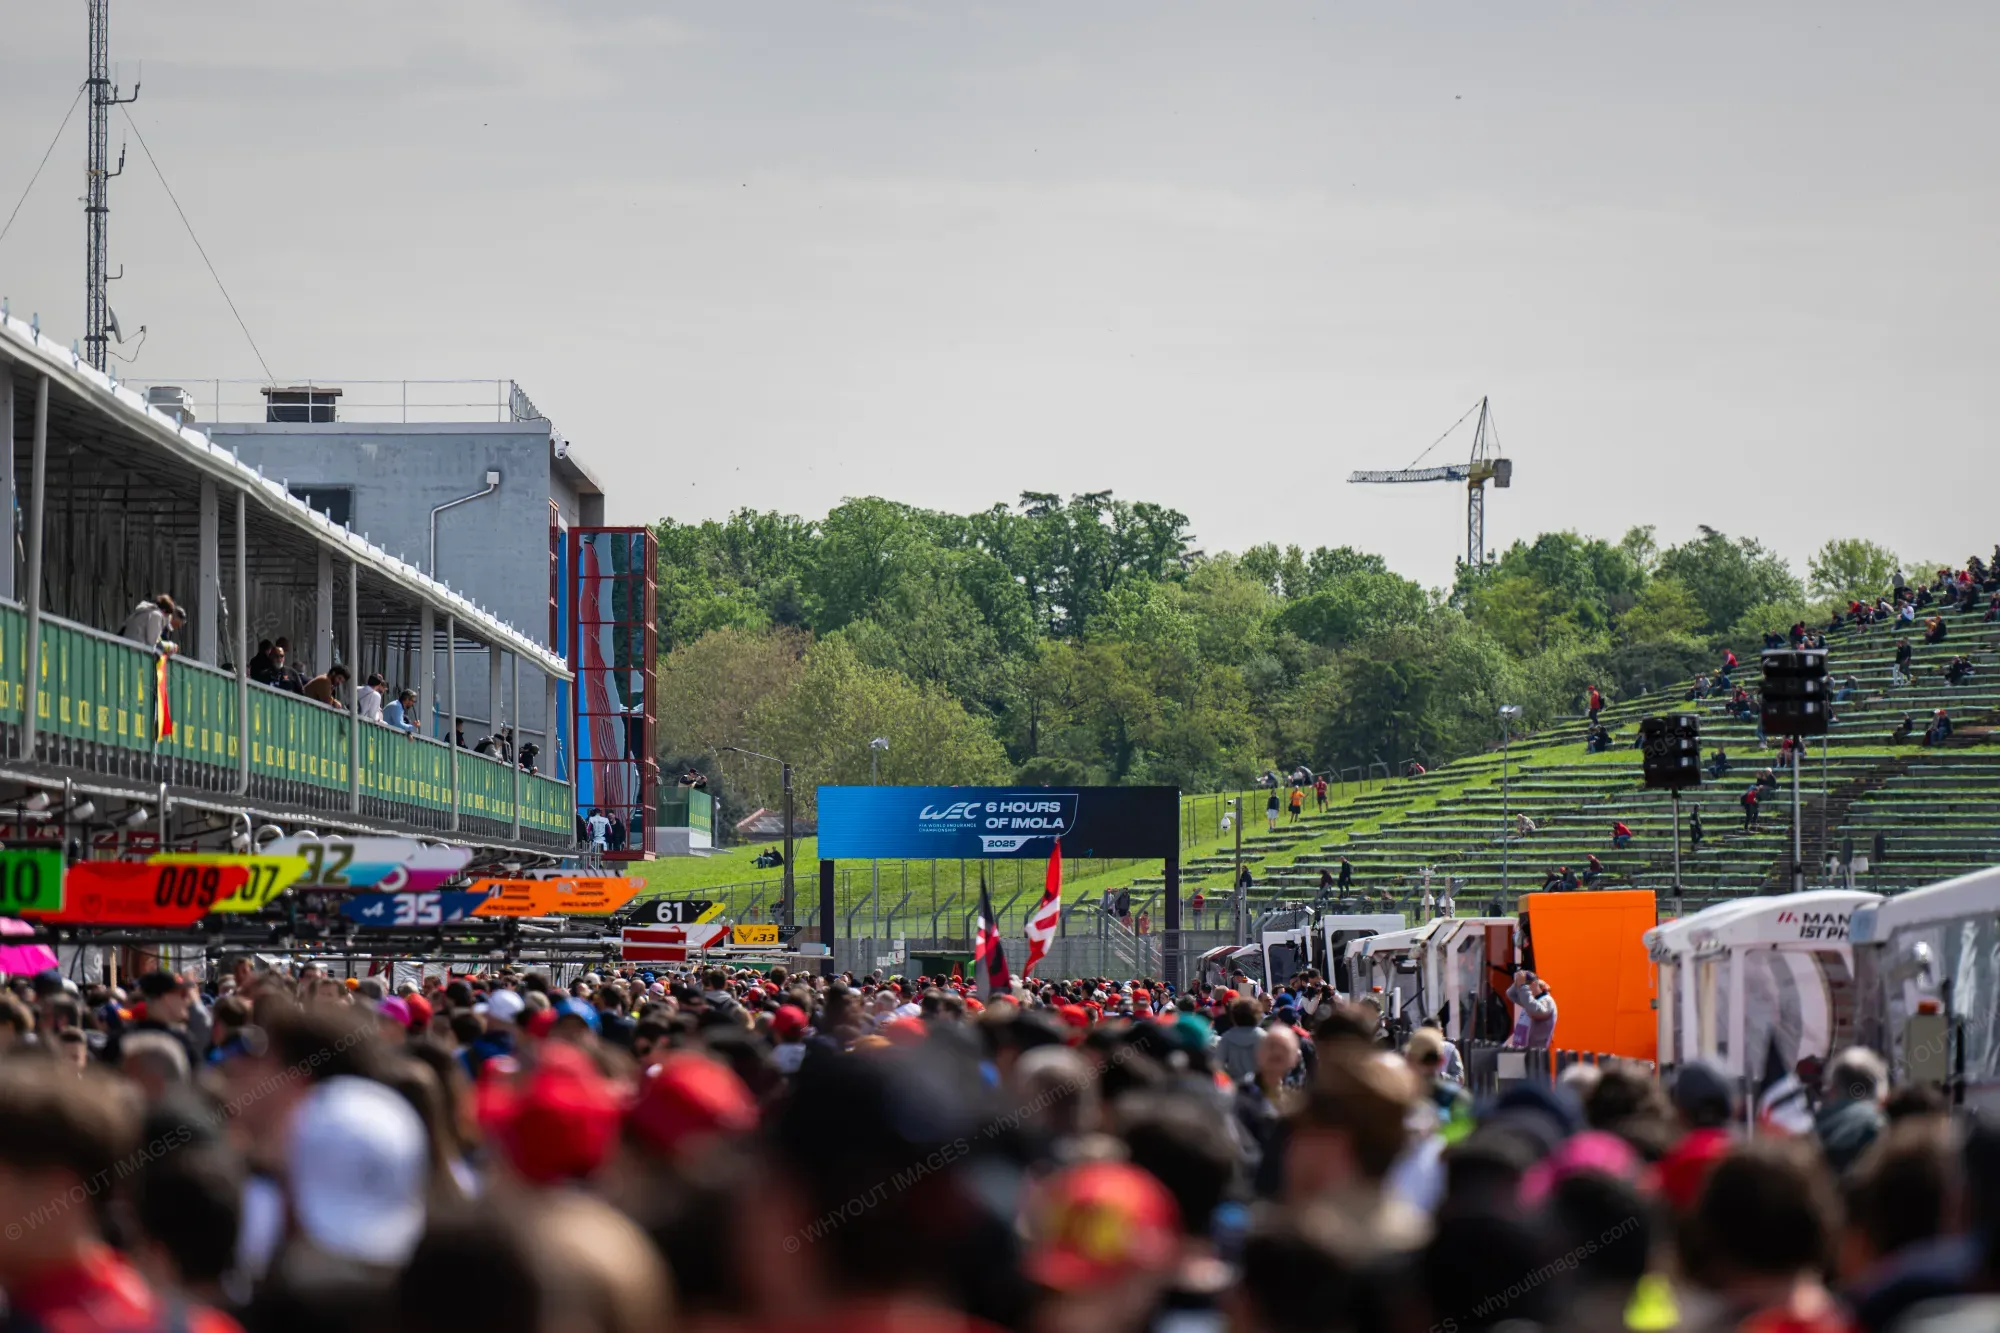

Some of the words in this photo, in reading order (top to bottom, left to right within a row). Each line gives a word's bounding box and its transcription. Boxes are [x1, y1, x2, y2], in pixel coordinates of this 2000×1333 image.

[919, 802, 981, 820] WEC
[985, 801, 998, 813] 6
[1000, 801, 1061, 813] HOURS
[985, 817, 1009, 829] OF
[1011, 817, 1065, 829] IMOLA
[987, 840, 1017, 848] 2025
[296, 843, 355, 884] 92
[155, 865, 221, 908] 009
[392, 893, 442, 925] 35
[656, 901, 683, 923] 61
[753, 933, 776, 942] #33
